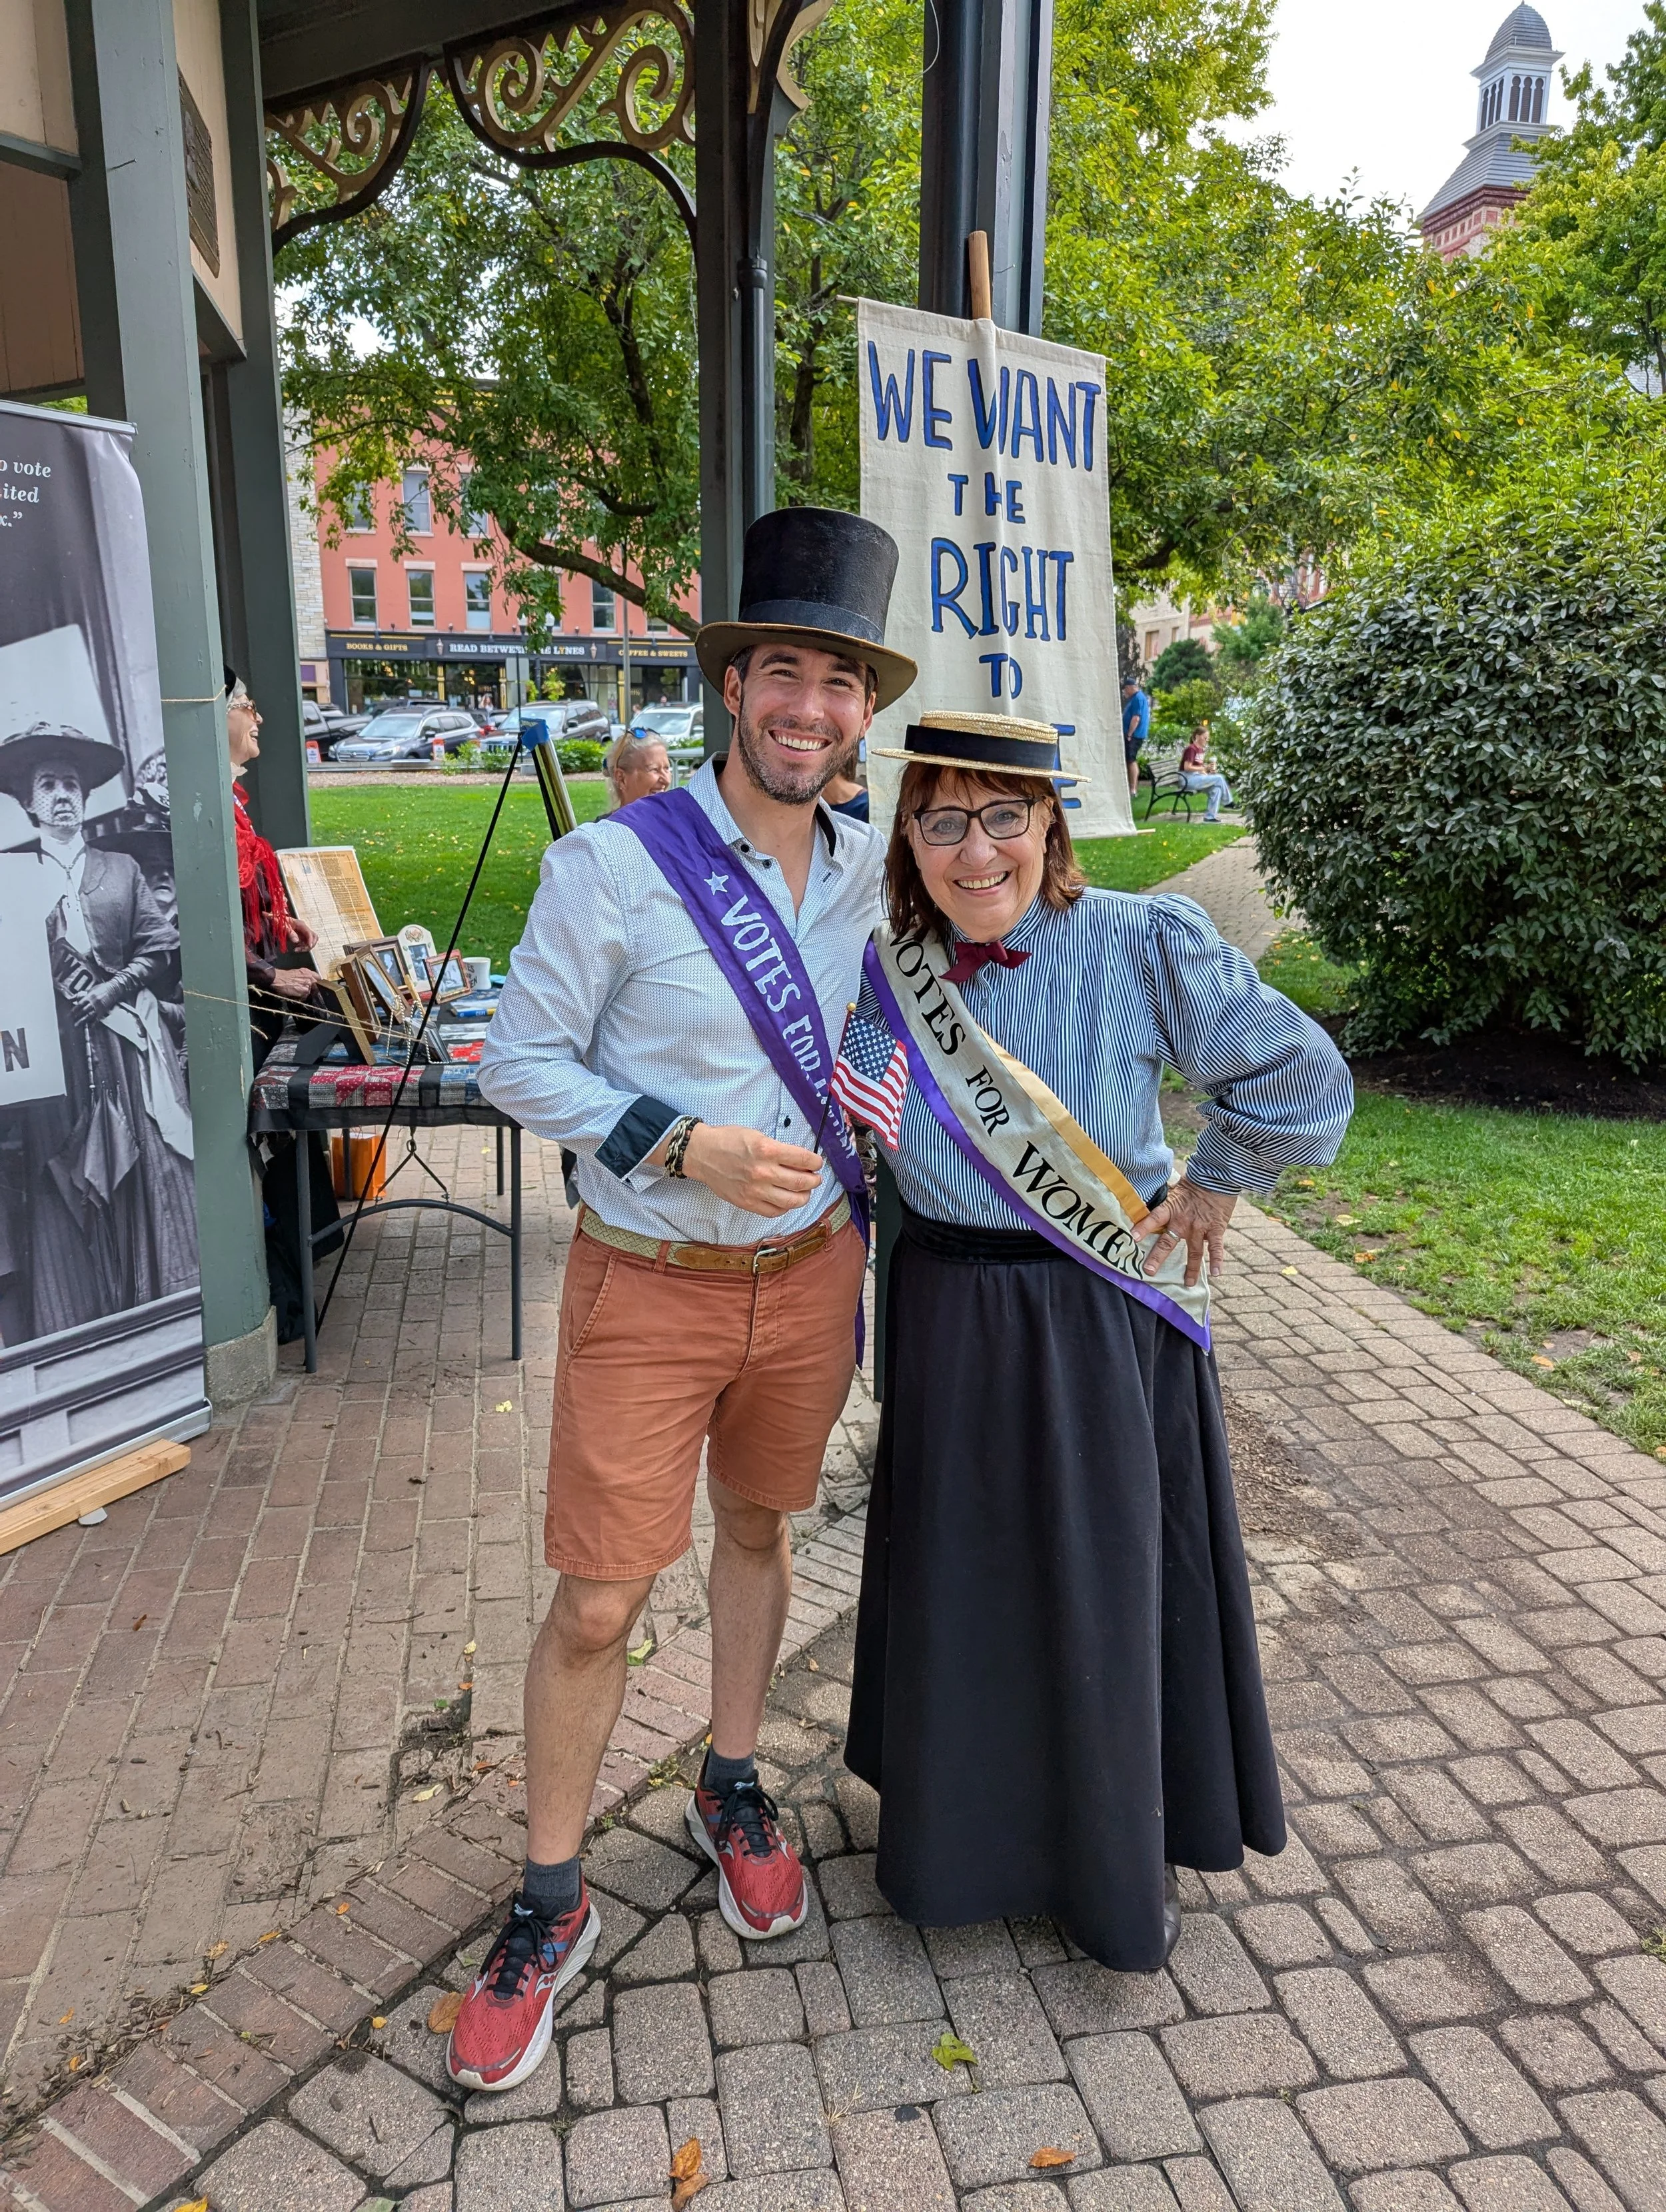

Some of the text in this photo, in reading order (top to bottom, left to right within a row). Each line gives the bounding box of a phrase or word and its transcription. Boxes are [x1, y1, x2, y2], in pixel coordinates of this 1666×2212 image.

[867, 340, 1102, 472] WE WANT
[0, 483, 40, 503] ited
[13, 462, 51, 478] vote
[931, 536, 1075, 642] RIGHT
[449, 644, 478, 653] READ
[553, 646, 585, 655] LYNES
[979, 653, 1022, 700] TO
[720, 894, 801, 1012] VOTES
[965, 1064, 1010, 1137] FOR
[1012, 1140, 1146, 1280] WOMEN
